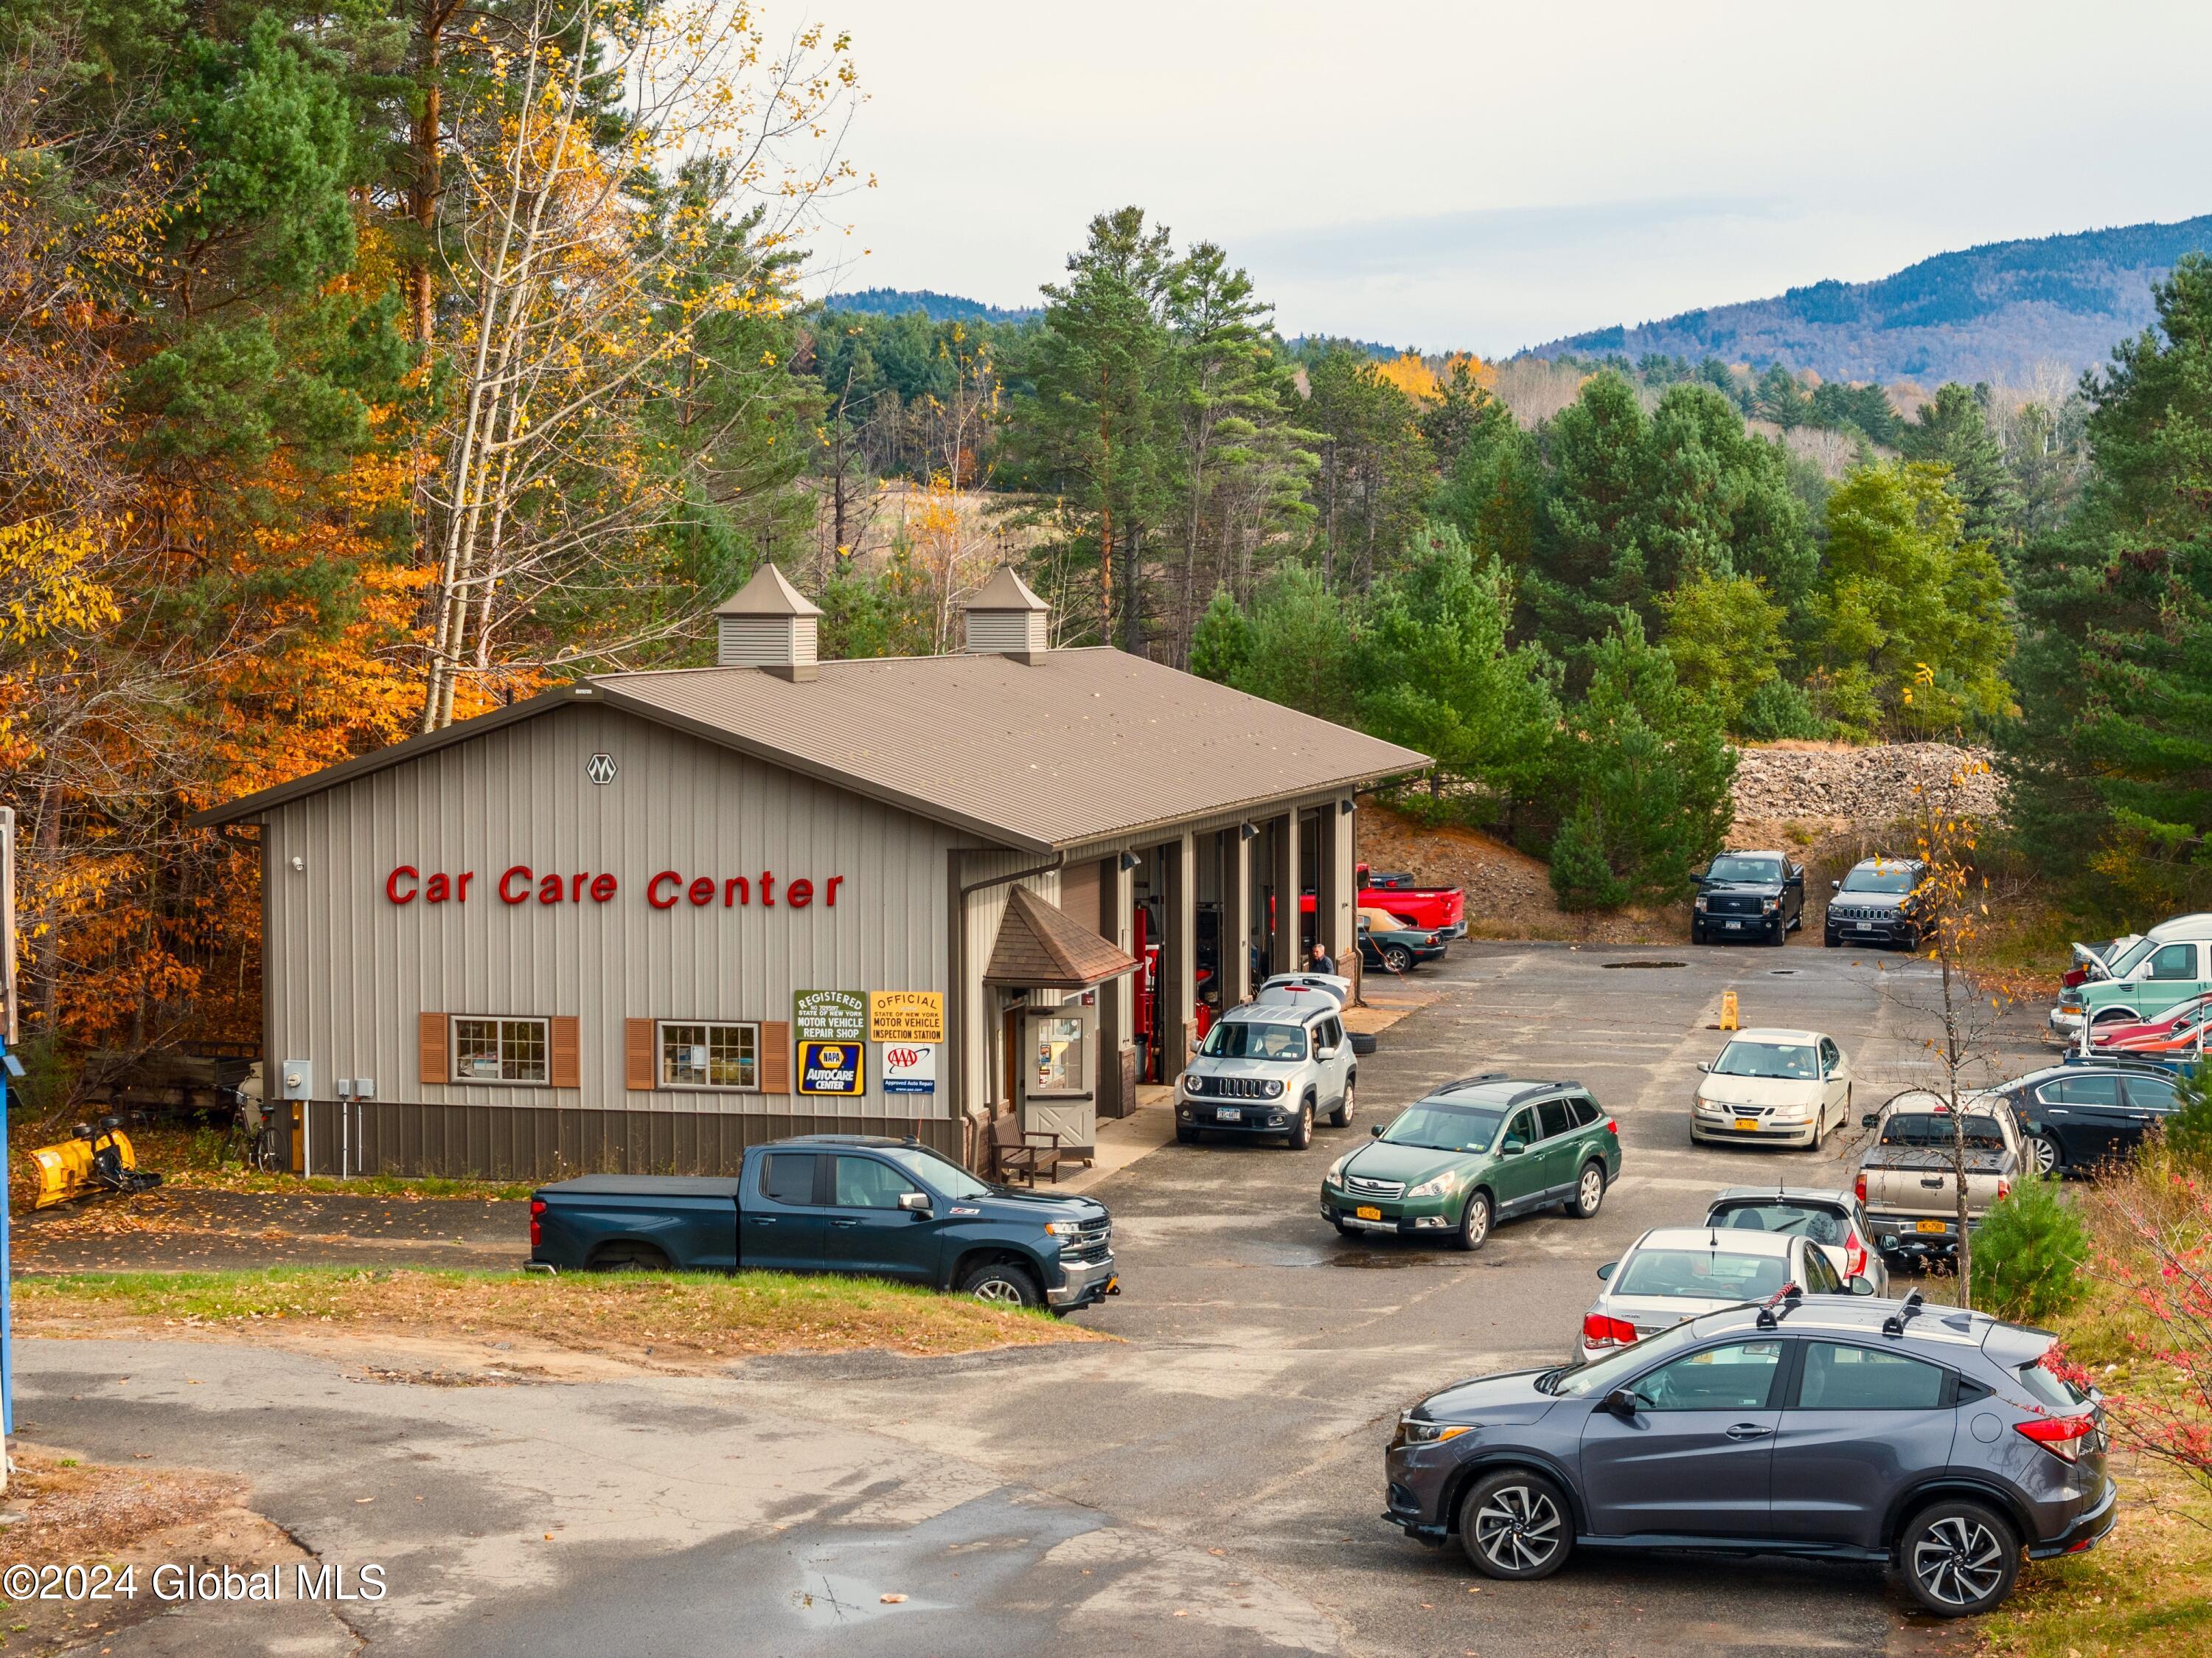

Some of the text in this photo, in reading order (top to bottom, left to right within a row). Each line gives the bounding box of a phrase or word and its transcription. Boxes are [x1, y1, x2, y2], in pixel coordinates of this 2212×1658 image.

[386, 865, 844, 909] Car Care Center
[798, 991, 863, 1010] REGISTERED
[877, 994, 937, 1010] OFFICIAL
[798, 1017, 863, 1027] MOTOR VEHICLE
[874, 1018, 940, 1027] MOTOR VEHICLE
[804, 1028, 859, 1038] REPAIR SHOP
[873, 1030, 941, 1039] INSPECTION STATION
[824, 1052, 840, 1062] NAPA
[888, 1048, 917, 1067] AAA
[815, 1081, 844, 1090] CENTER
